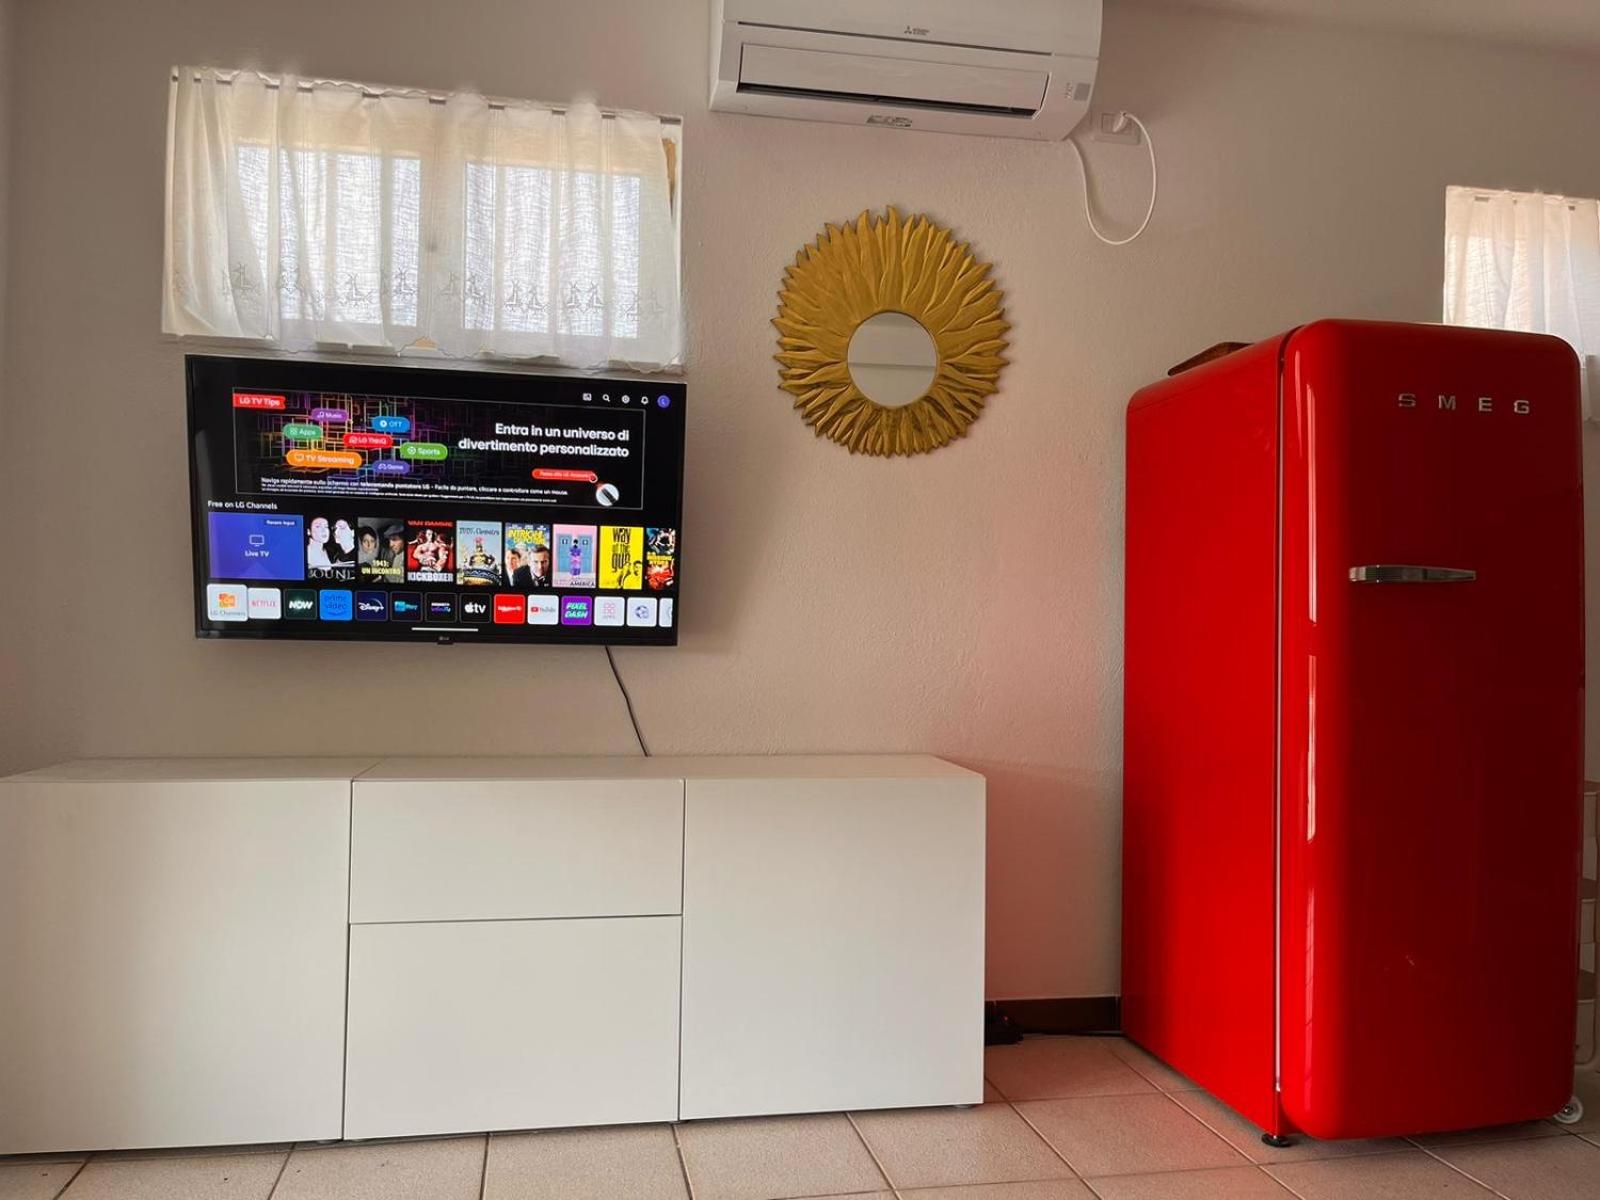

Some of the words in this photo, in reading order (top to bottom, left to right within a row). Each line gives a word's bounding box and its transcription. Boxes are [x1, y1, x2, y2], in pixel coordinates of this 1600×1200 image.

[239, 396, 252, 405] LG
[252, 397, 263, 405] TV
[264, 398, 280, 407] Tips
[1397, 392, 1531, 415] SMEG
[299, 428, 316, 437] Apps
[495, 422, 529, 436] Entra
[531, 424, 543, 436] in
[545, 427, 561, 438] un
[563, 427, 616, 440] universo
[617, 429, 630, 441] di
[417, 447, 440, 457] Sports
[458, 437, 538, 453] divertimento
[540, 445, 630, 458] personalizzato
[306, 455, 318, 463] TV
[317, 455, 355, 465] Streaming
[207, 500, 223, 508] Free
[235, 501, 245, 509] LG
[246, 502, 278, 510] Channels
[612, 527, 632, 545] way
[407, 571, 454, 582] KICKBOXER
[251, 600, 277, 608] NETFLIX
[288, 600, 313, 610] NOW
[325, 601, 347, 610] video
[566, 602, 588, 611] PIXEL
[564, 610, 588, 619] DASH
